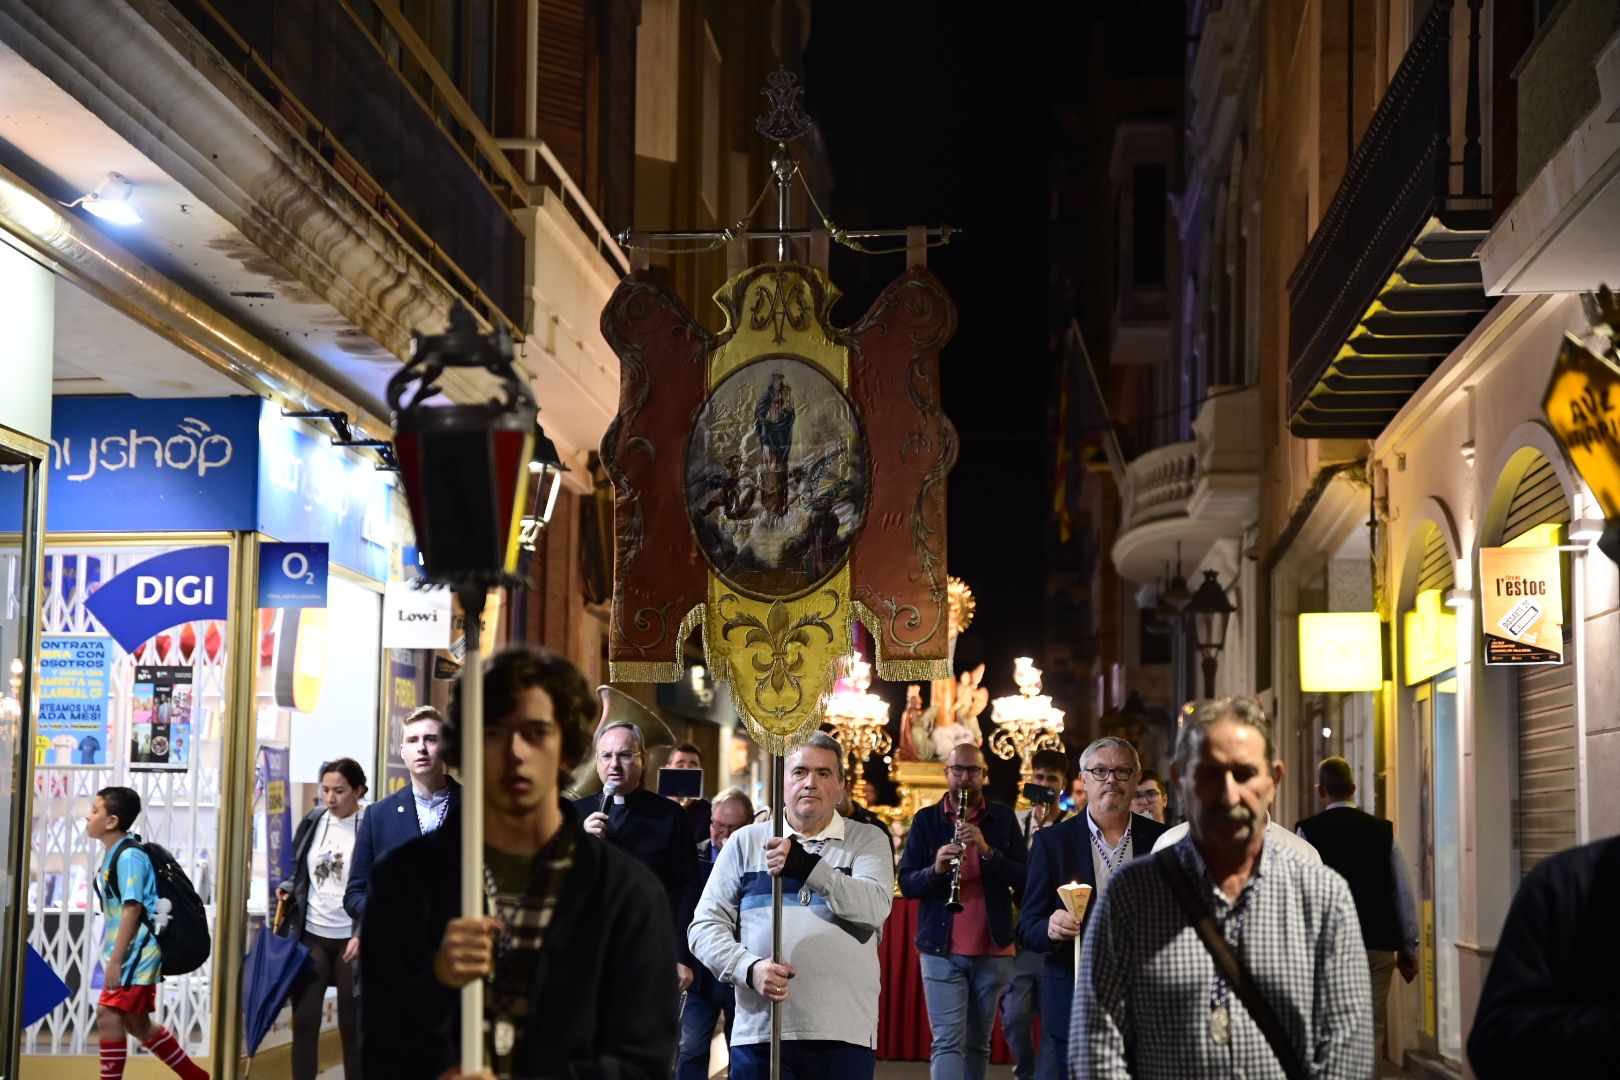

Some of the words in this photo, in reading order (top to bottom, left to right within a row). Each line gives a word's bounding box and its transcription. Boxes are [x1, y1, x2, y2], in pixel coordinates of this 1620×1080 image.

[46, 417, 234, 482] nyshop
[136, 575, 213, 606] DIGI
[1496, 578, 1546, 596] l'estoc
[398, 610, 438, 623] Lowi
[41, 641, 104, 649] ONTRATA
[40, 659, 104, 668] OSOTROS
[39, 703, 81, 712] RTEAMOS
[83, 703, 101, 712] UNA
[38, 712, 66, 720] ADA
